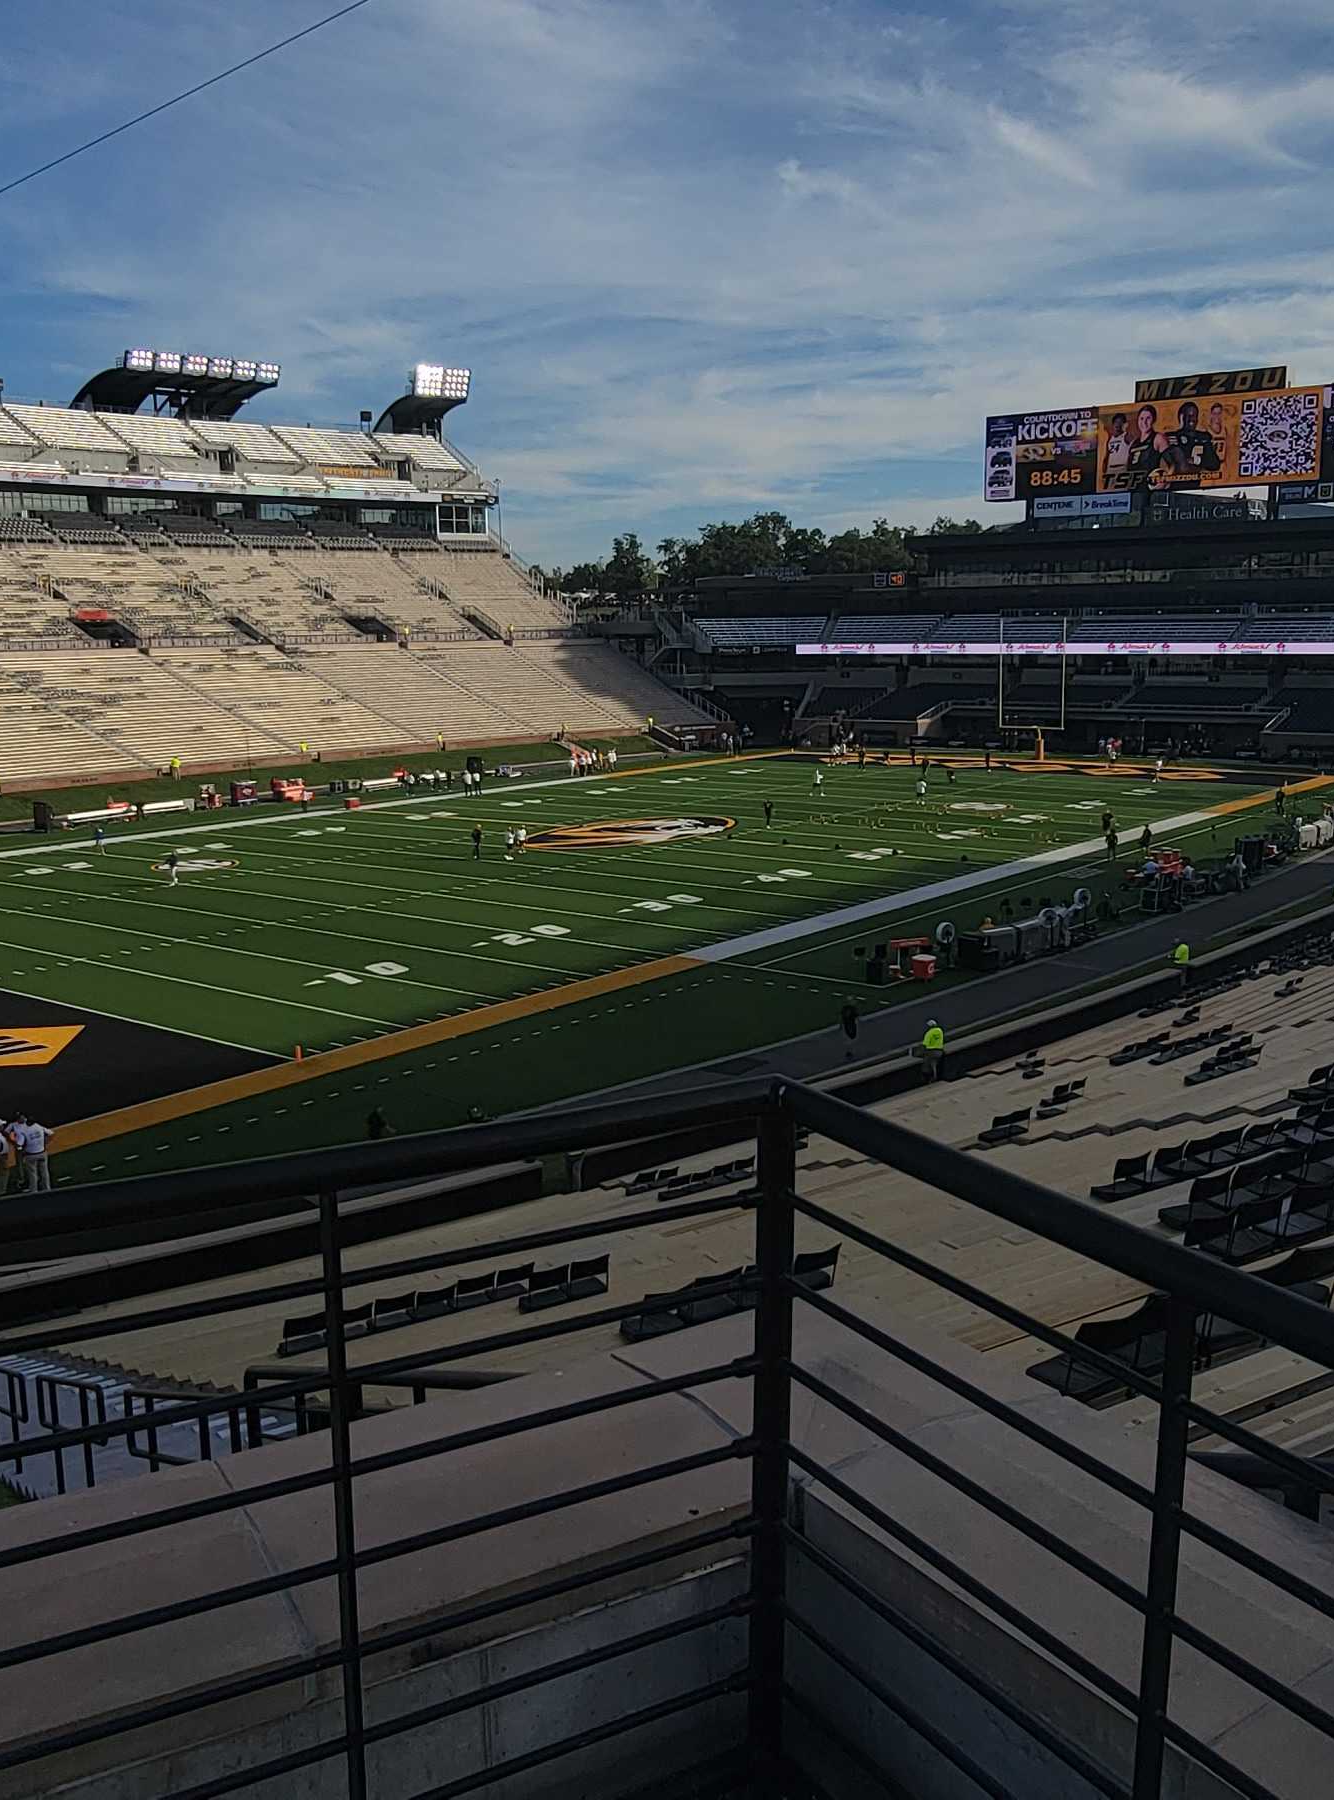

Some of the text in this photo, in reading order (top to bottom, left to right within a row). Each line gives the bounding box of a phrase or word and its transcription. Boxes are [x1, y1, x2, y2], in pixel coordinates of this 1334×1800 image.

[1137, 368, 1283, 400] MIZZOU
[1024, 412, 1078, 424] COUNTDOWN
[1017, 419, 1098, 441] KICKOFF
[1030, 469, 1081, 486] 88:45
[1169, 504, 1242, 520] Health Care
[756, 868, 814, 884] 40
[633, 892, 704, 913] 30
[490, 924, 571, 947] 20
[324, 960, 410, 985] 10
